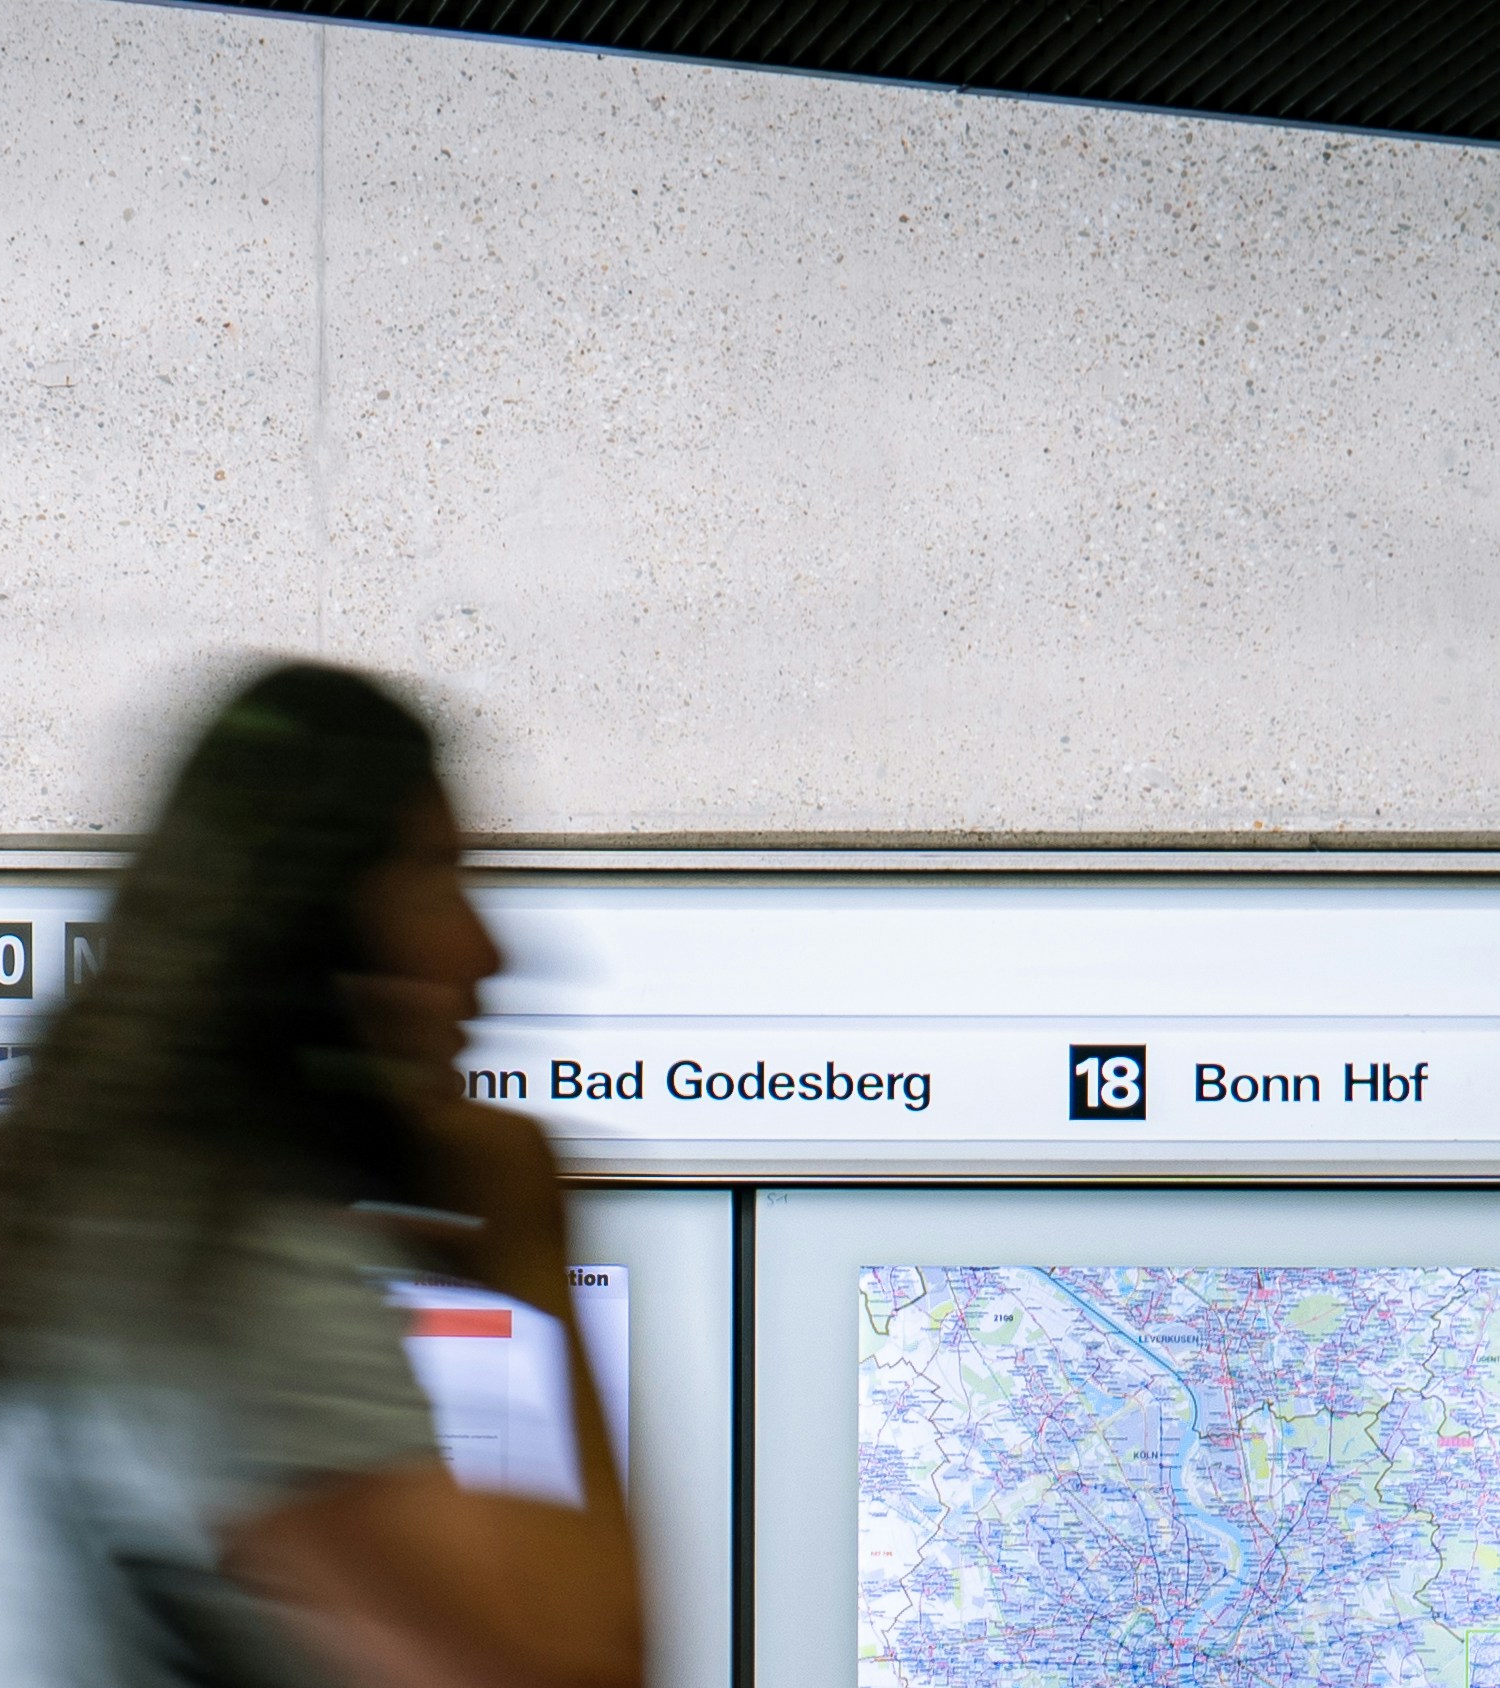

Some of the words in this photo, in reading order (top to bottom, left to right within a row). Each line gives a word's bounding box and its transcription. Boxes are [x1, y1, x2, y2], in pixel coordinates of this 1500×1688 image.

[460, 1068, 528, 1100] nn
[551, 1059, 644, 1100] Bad
[666, 1060, 931, 1112] Godesberg
[1075, 1056, 1140, 1109] 18
[1195, 1063, 1320, 1103] Bonn
[1344, 1062, 1429, 1102] Hbf
